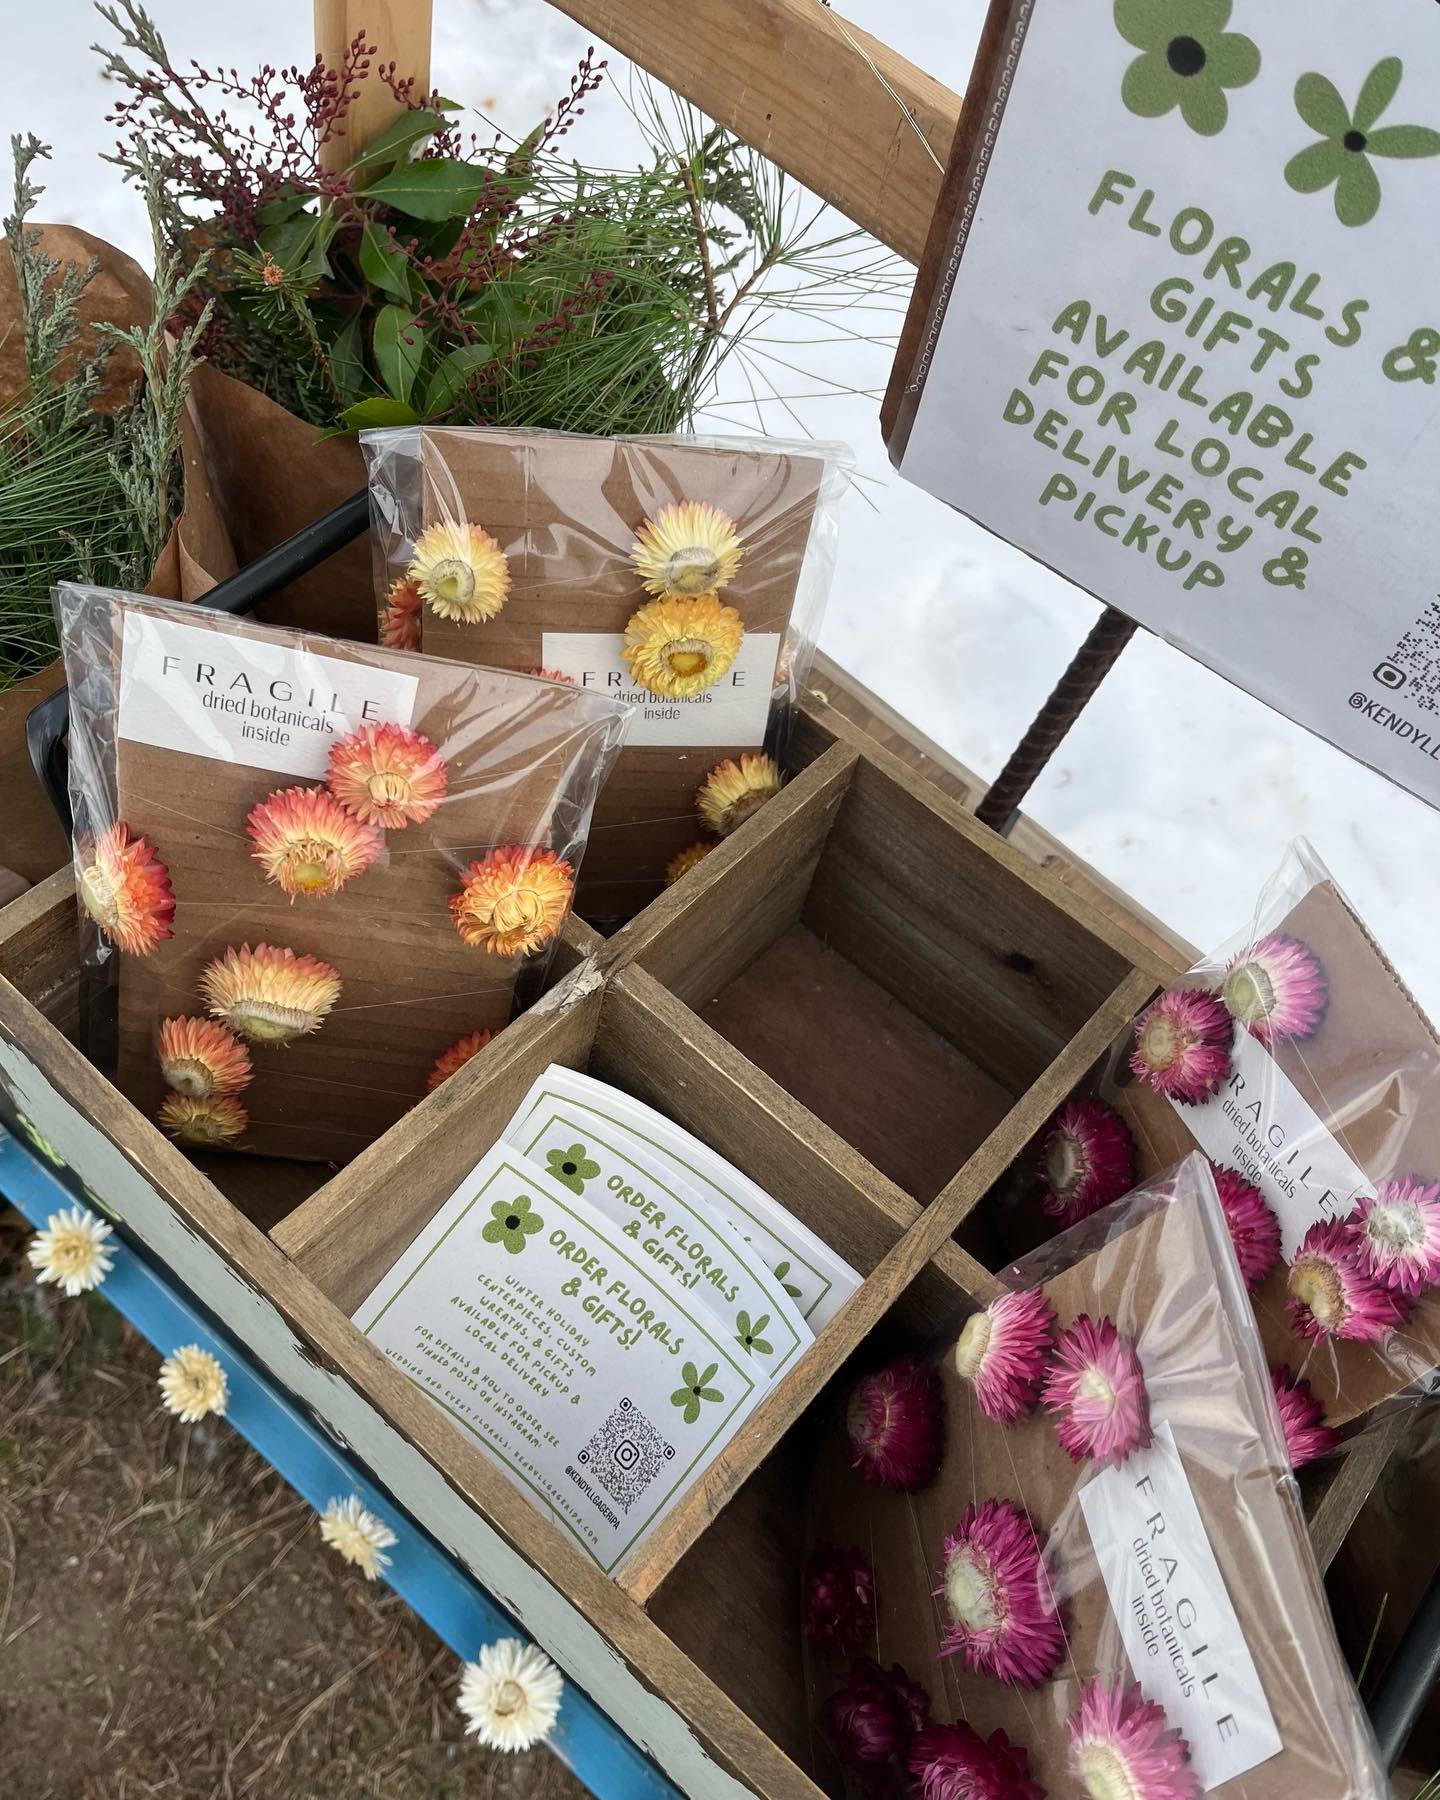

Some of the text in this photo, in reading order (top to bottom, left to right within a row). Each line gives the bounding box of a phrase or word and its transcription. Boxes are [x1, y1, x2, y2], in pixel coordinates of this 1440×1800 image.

[1088, 170, 1440, 384] FLORALS &
[1150, 277, 1320, 399] GIFTS
[1052, 300, 1367, 496] AVAILABLE
[1028, 349, 1322, 544] FOR LOCAL
[1003, 387, 1309, 590] DELIVERY &
[1039, 473, 1225, 590] PICKUP
[162, 655, 381, 722] FRAGILE
[202, 690, 334, 735] dried botanicals
[613, 690, 646, 704] dried
[644, 707, 681, 720] inside
[241, 721, 291, 746] inside
[1222, 1099, 1298, 1199] dried botanicals
[1228, 1073, 1338, 1214] RAGILE
[1231, 1142, 1263, 1184] inside
[607, 1174, 739, 1302] ORDER FLORALS
[622, 1220, 641, 1239] &
[505, 1274, 590, 1347] WINTER HOLIDAY
[549, 1229, 685, 1355] ORDER FLORALS
[560, 1276, 643, 1351] & GIFTS!
[385, 1348, 423, 1376] WEDDING
[424, 1376, 442, 1390] AND
[444, 1390, 471, 1413] EVENT
[414, 1325, 560, 1448] FOR DETAILS & HOW TO ORDER SEE
[416, 1342, 449, 1366] PINNED
[449, 1366, 478, 1391] POSTS
[479, 1390, 493, 1403] ON
[450, 1296, 581, 1405] AVAILABLE FOR PICKUP &
[464, 1324, 549, 1397] LOCAL DELIVERY
[532, 1338, 543, 1348] &
[544, 1349, 574, 1377] GIFTS
[556, 1338, 597, 1377] CUSTOM
[564, 1465, 621, 1531] @KENDYLLGAGERIPA
[1131, 1595, 1160, 1657] inside
[1132, 1537, 1195, 1698] dried botanicals
[1134, 1475, 1240, 1743] FRAGILE
